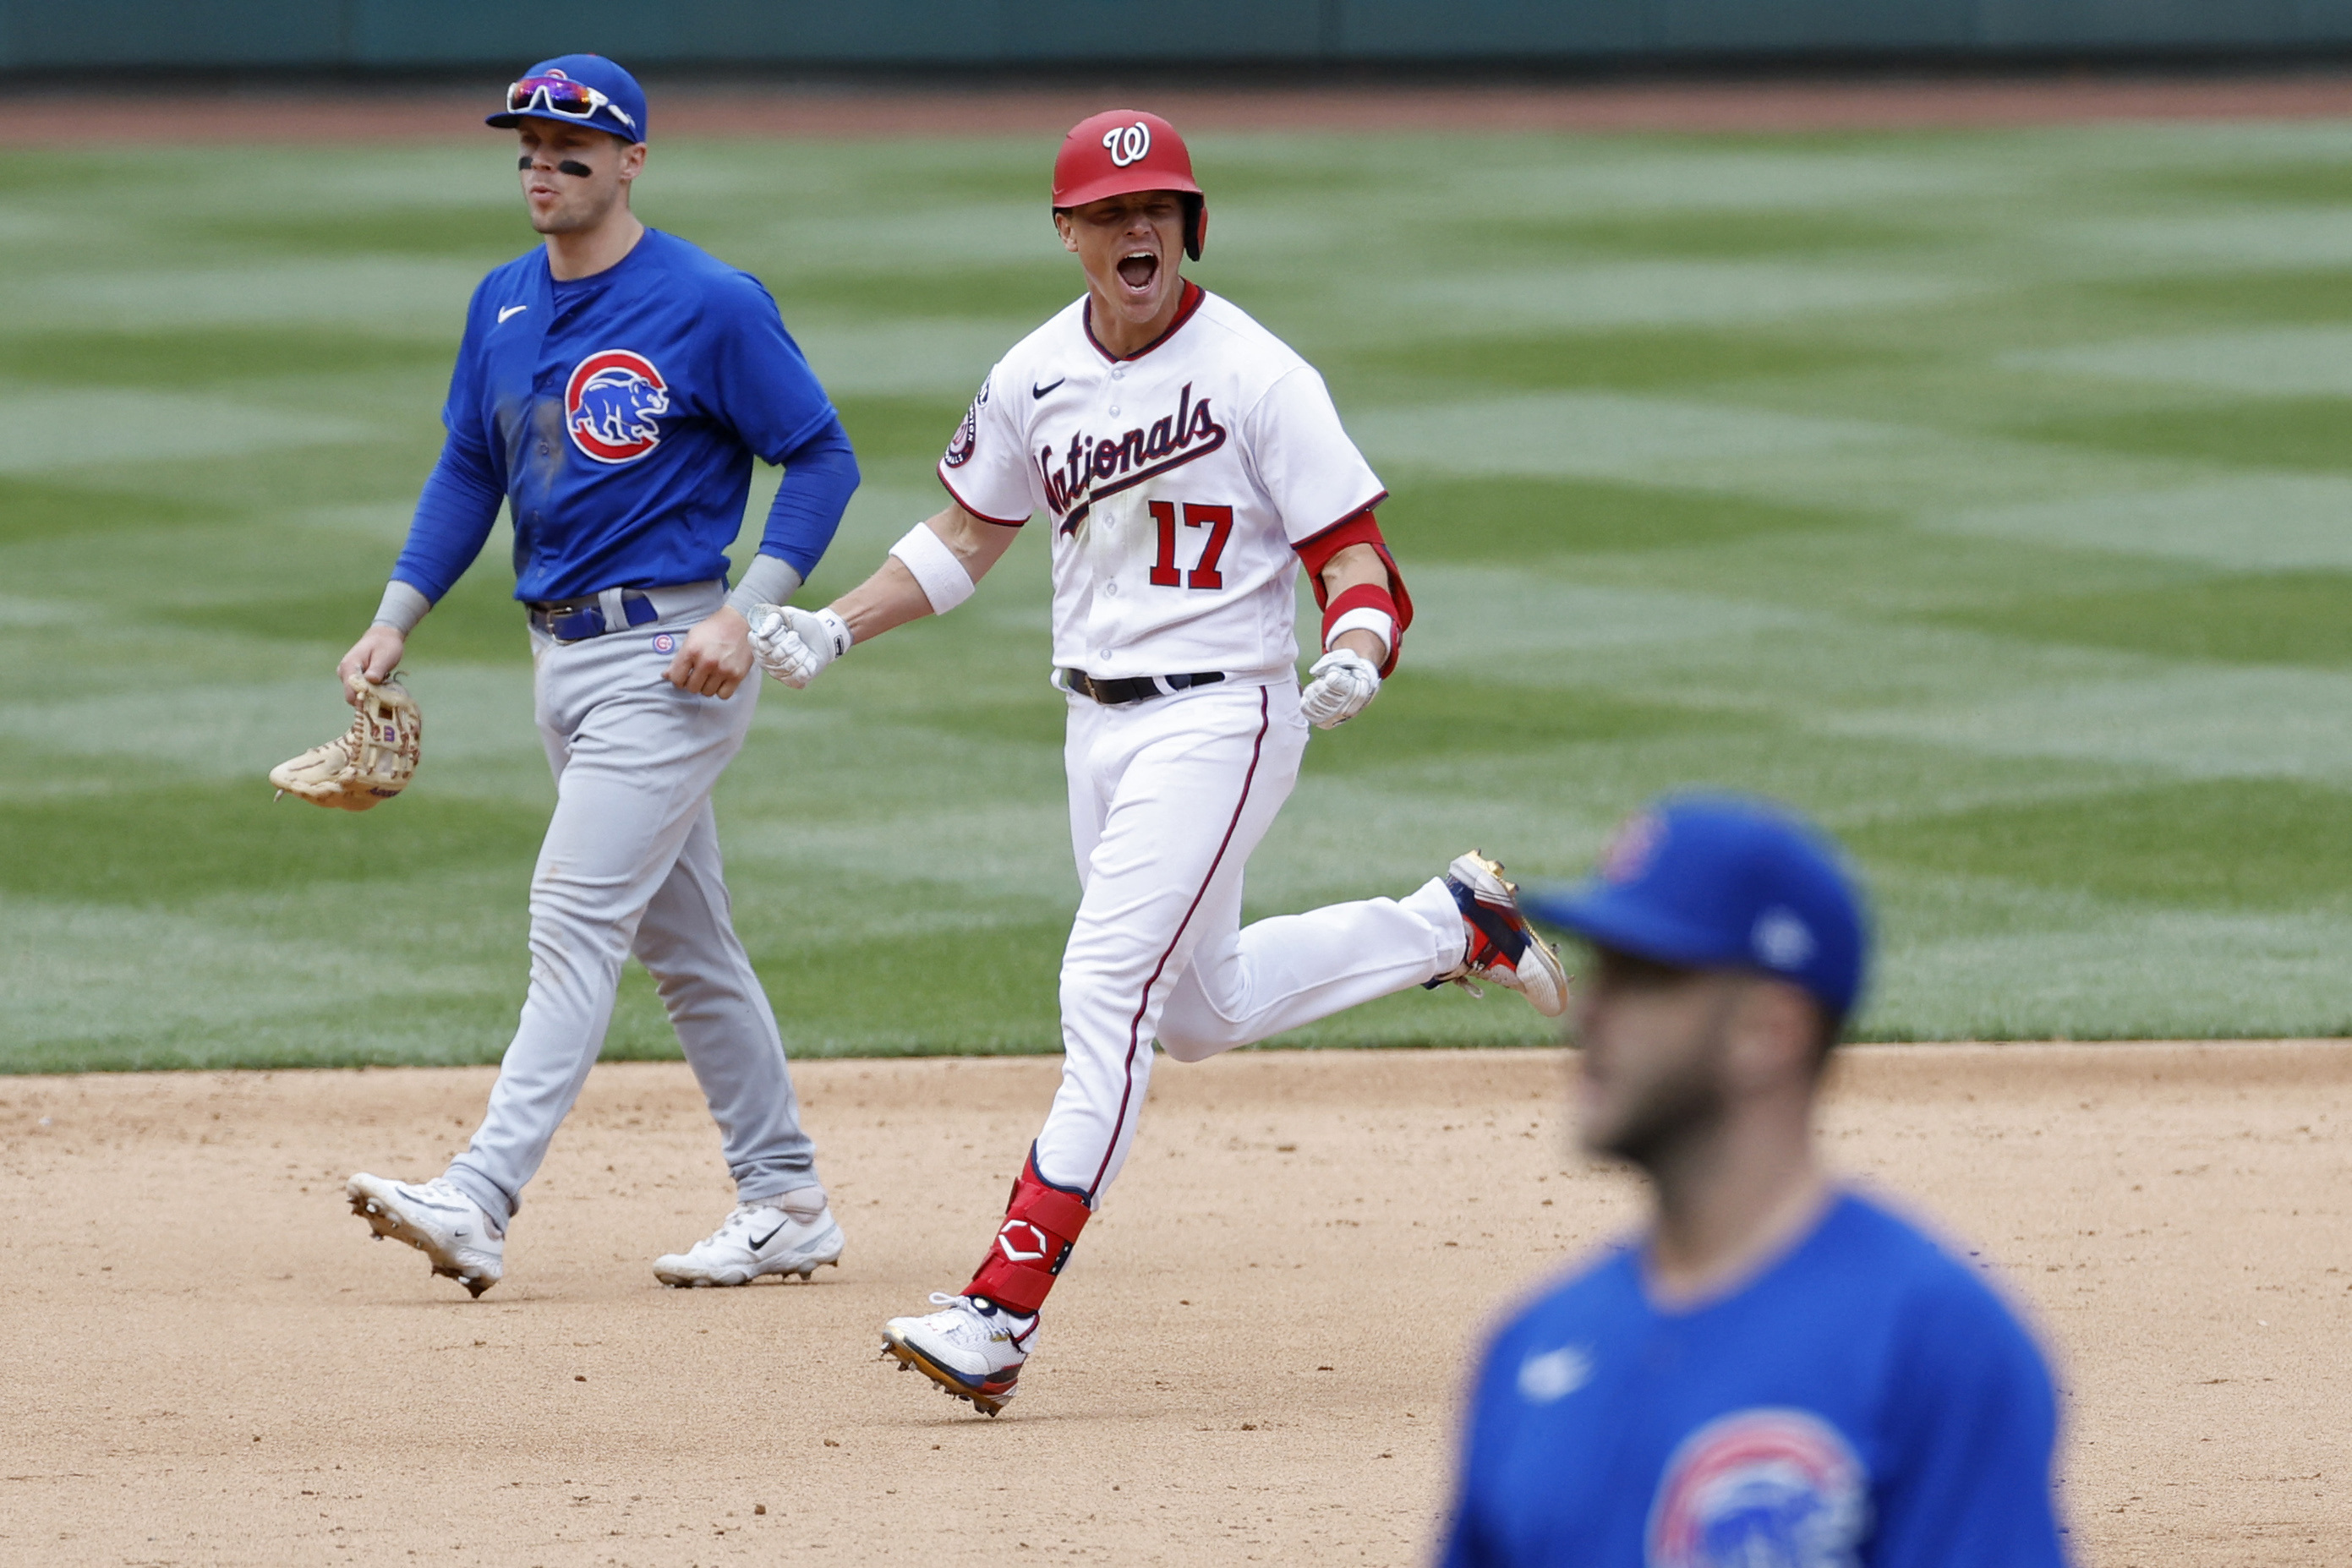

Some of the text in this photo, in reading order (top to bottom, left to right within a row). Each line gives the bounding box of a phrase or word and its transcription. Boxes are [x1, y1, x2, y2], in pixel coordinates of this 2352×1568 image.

[1102, 122, 1151, 167] W
[1033, 381, 1227, 539] Nationals
[1148, 500, 1233, 589] 17
